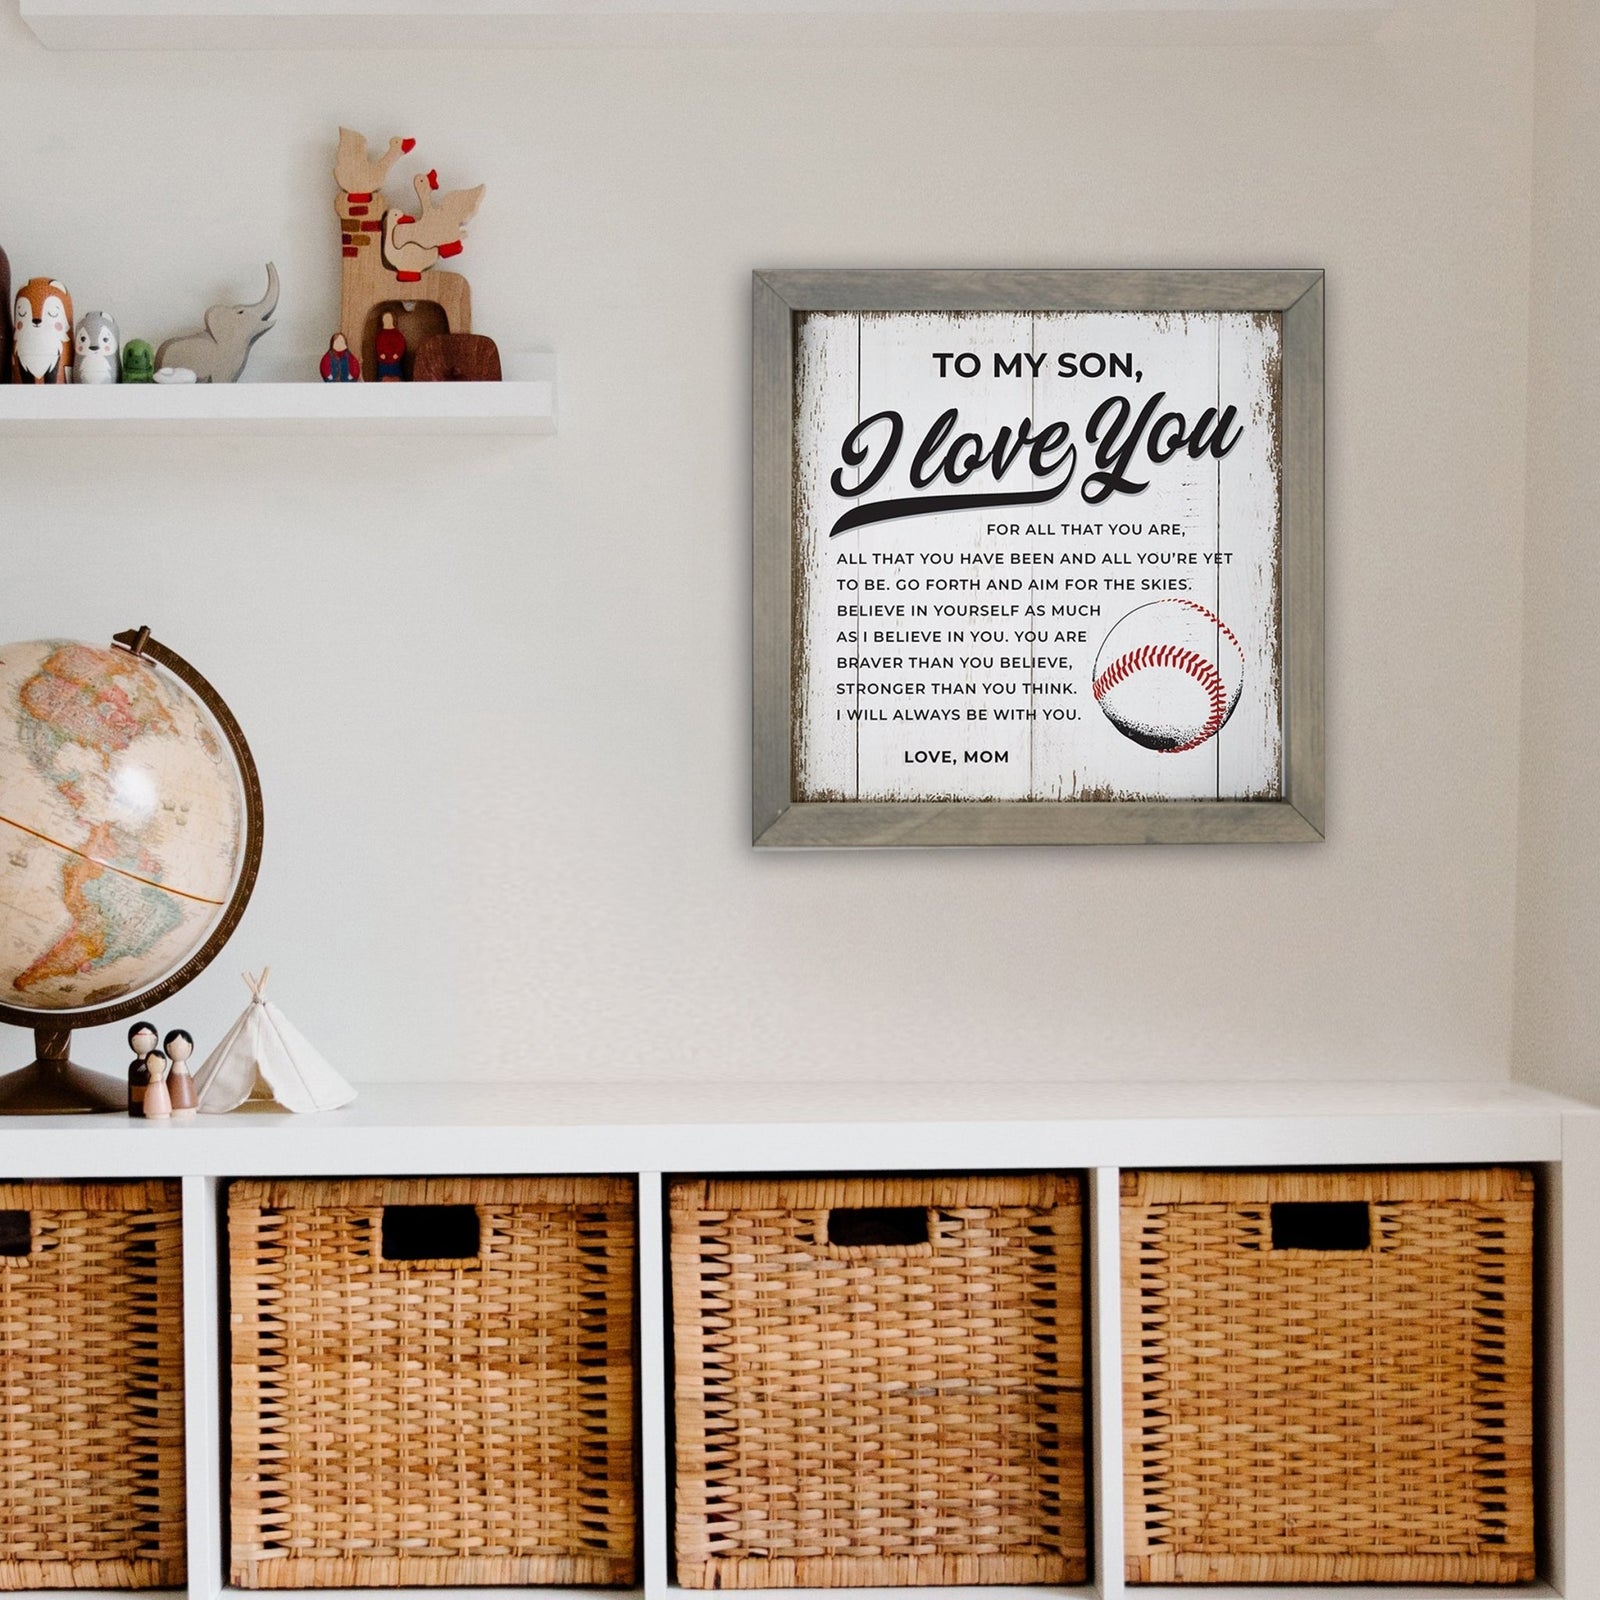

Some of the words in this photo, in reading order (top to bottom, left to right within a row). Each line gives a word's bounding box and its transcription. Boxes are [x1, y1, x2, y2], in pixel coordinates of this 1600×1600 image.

[932, 352, 982, 378] TO
[993, 352, 1048, 378] MY
[1057, 352, 1143, 383] SON,
[830, 411, 904, 498] I
[1081, 392, 1244, 505] You
[987, 523, 1020, 536] FOR
[1025, 524, 1056, 536] ALL
[1060, 523, 1104, 536] THAT
[1108, 523, 1142, 536] YOU
[1148, 523, 1187, 538] ARE,
[836, 553, 867, 565] ALL
[871, 553, 915, 565] THAT
[919, 552, 954, 565] YOU
[960, 553, 1004, 565] HAVE
[1010, 553, 1054, 565] BEEN
[1059, 553, 1096, 565] AND
[1101, 553, 1132, 565] ALL
[1137, 552, 1198, 565] YOU'RE
[1203, 552, 1233, 565] YET
[836, 579, 859, 591] TO
[864, 579, 890, 591] BE.
[895, 578, 920, 591] GO
[926, 579, 980, 591] FORTH
[986, 579, 1023, 591] AND
[1027, 579, 1059, 591] AIM
[1065, 578, 1098, 591] FOR
[1103, 578, 1136, 591] THE
[1141, 578, 1192, 591] SKIES.
[837, 605, 905, 617] BELIEVE
[911, 605, 928, 617] IN
[933, 604, 1020, 617] YOURSELF
[1024, 604, 1046, 617] AS
[1051, 604, 1101, 617] MUCH
[836, 631, 859, 643] AS
[874, 631, 942, 643] BELIEVE
[948, 631, 964, 643] IN
[970, 631, 1009, 643] YOU.
[1014, 630, 1048, 643] YOU
[1054, 630, 1087, 643] ARE
[837, 657, 903, 669] BRAVER
[908, 657, 954, 669] THAN
[959, 656, 994, 669] YOU
[1000, 657, 1073, 672] BELIEVE,
[836, 682, 926, 695] STRONGER
[931, 682, 977, 695] THAN
[982, 682, 1016, 695] YOU
[1021, 682, 1077, 695] THINK.
[846, 709, 888, 721] WILL
[892, 709, 961, 721] ALWAYS
[966, 709, 988, 721] BE
[993, 709, 1037, 721] WITH
[1042, 708, 1081, 721] YOU.
[904, 750, 957, 766] LOVE,
[964, 750, 1009, 764] MOM
